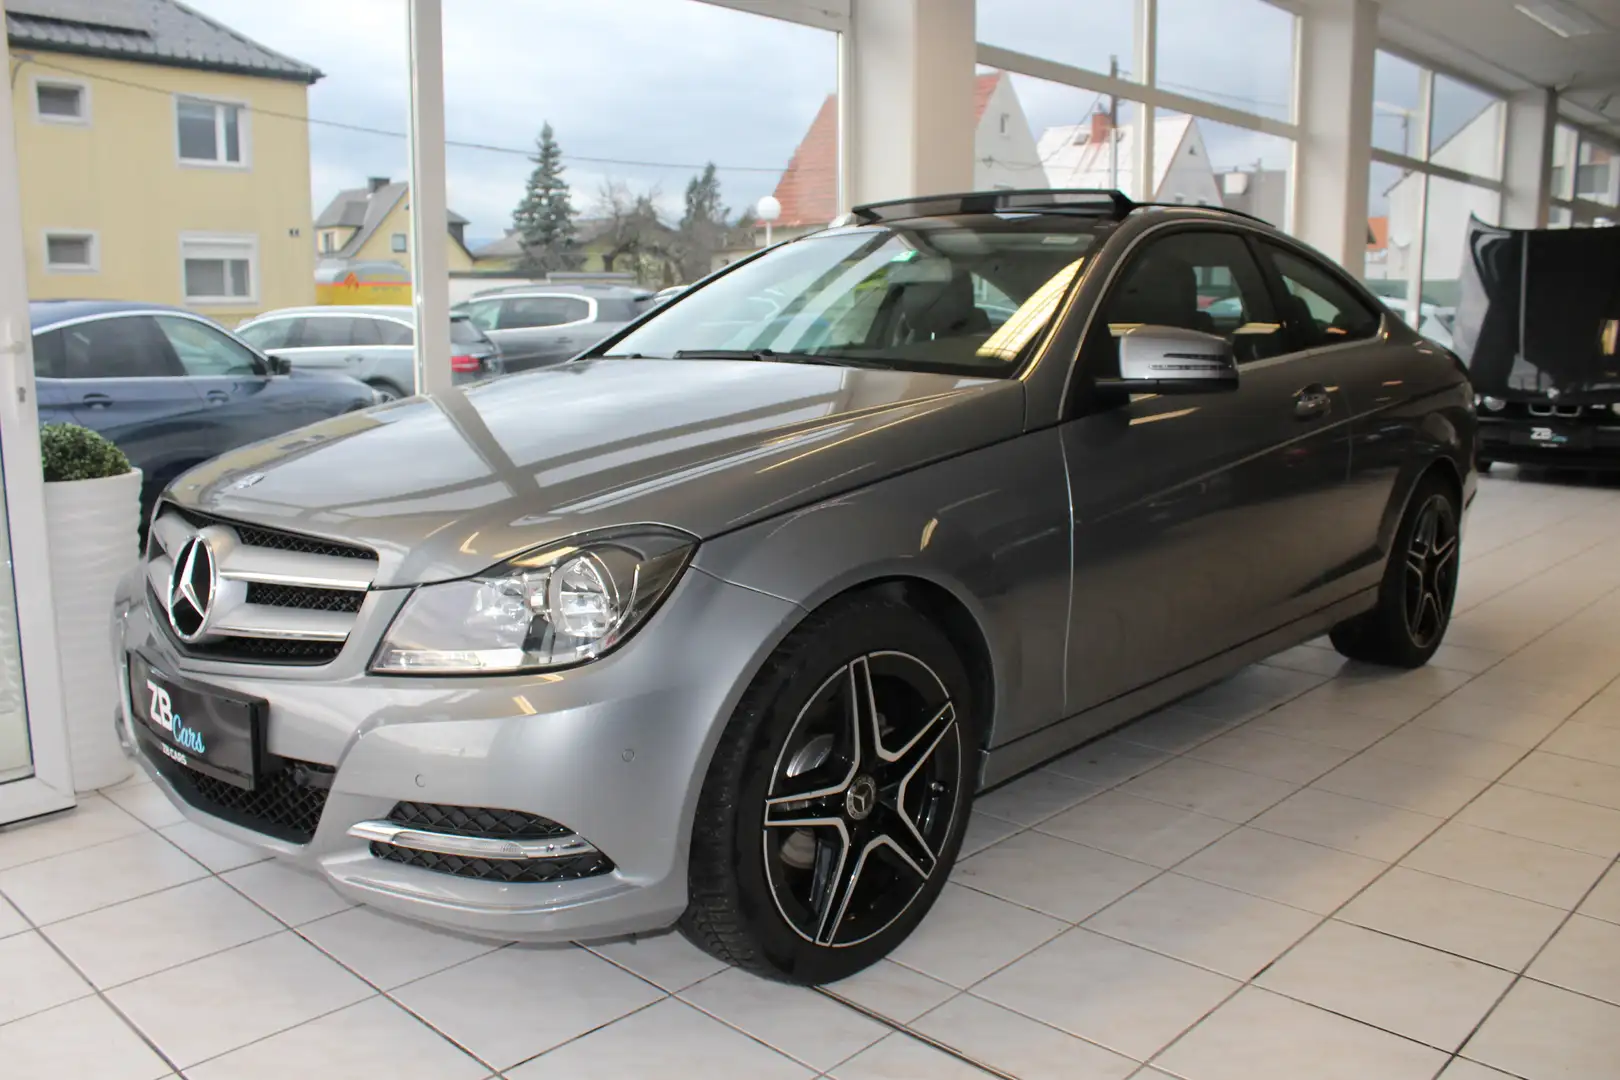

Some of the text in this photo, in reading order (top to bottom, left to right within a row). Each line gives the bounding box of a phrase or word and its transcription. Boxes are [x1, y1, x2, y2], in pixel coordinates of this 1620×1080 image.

[1530, 427, 1553, 440] ZB
[146, 680, 206, 753] ZB Cars
